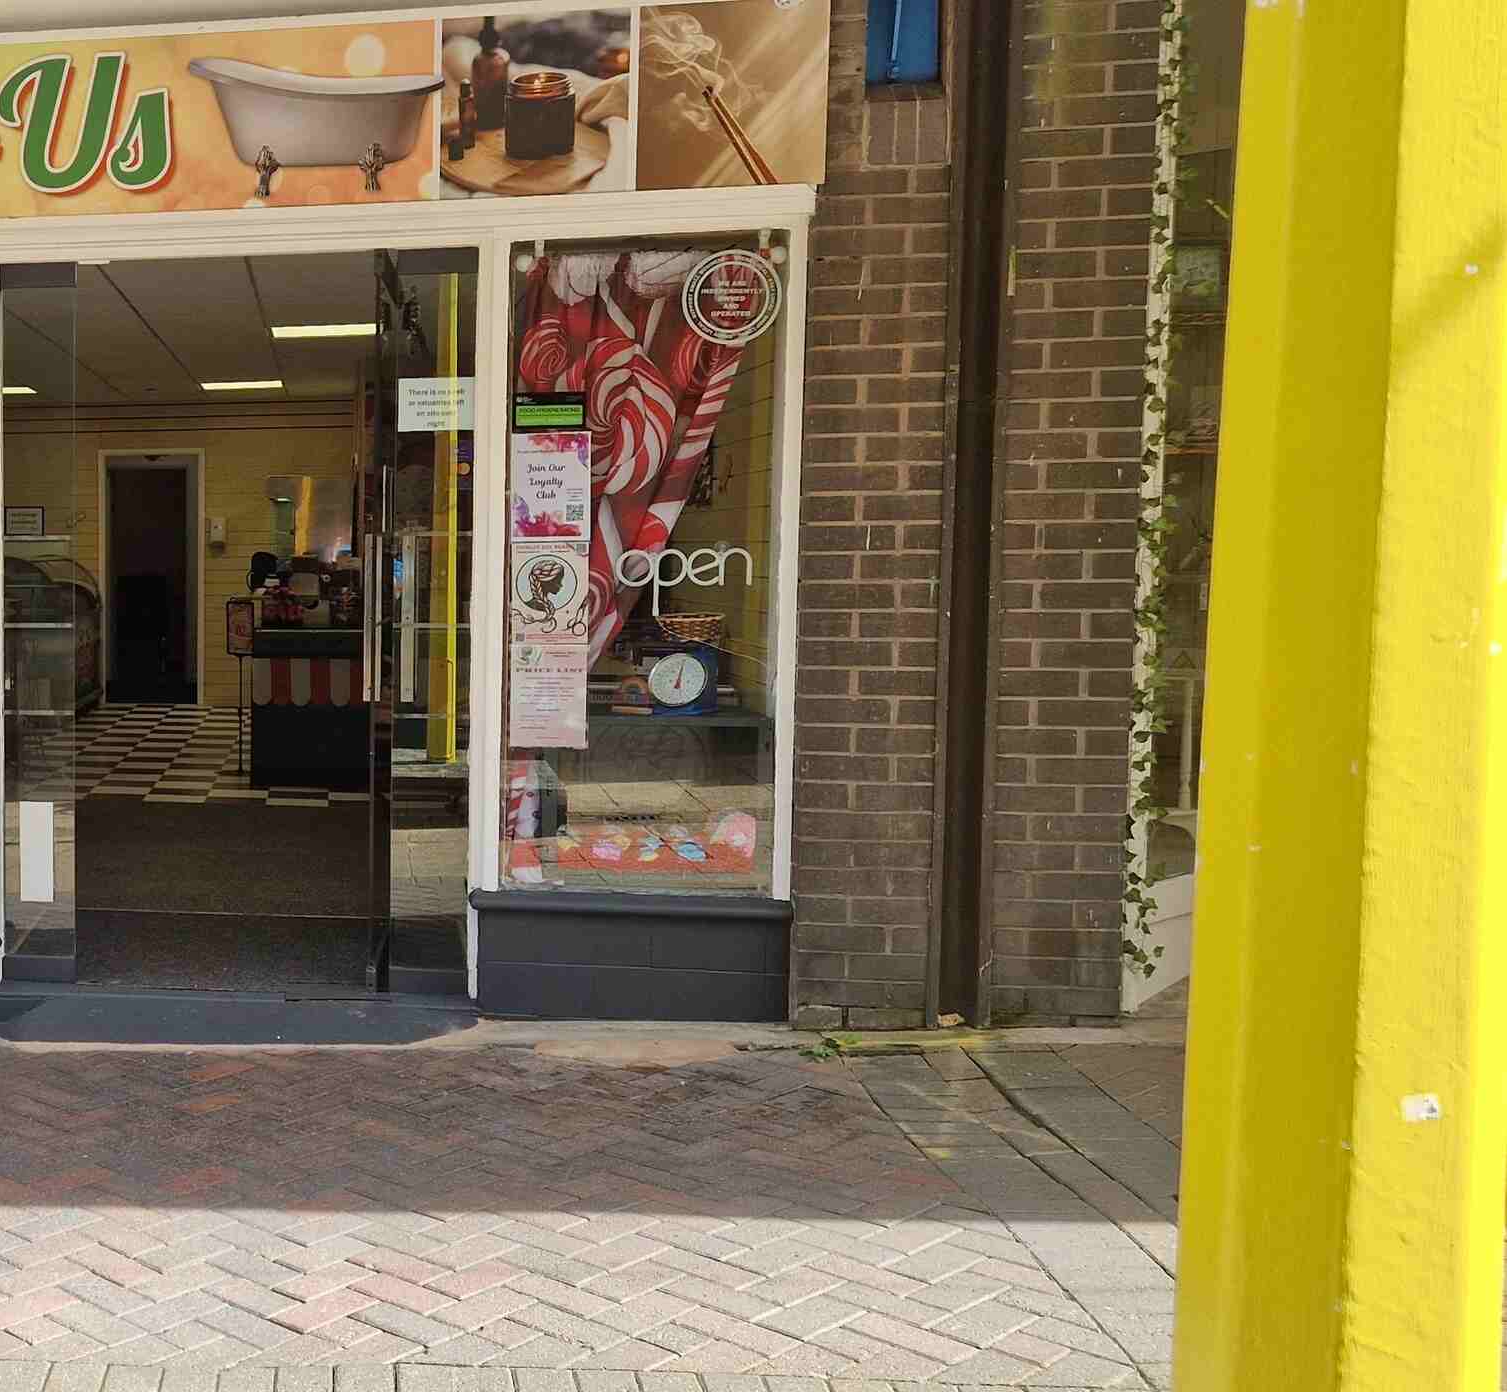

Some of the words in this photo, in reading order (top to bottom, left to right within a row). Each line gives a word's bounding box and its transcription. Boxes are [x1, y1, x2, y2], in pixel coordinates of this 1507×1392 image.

[408, 389, 428, 397] There
[527, 463, 546, 474] Join
[548, 463, 566, 473] Our
[528, 477, 564, 489] Loyalty
[536, 488, 557, 500] Club
[615, 547, 753, 617] open
